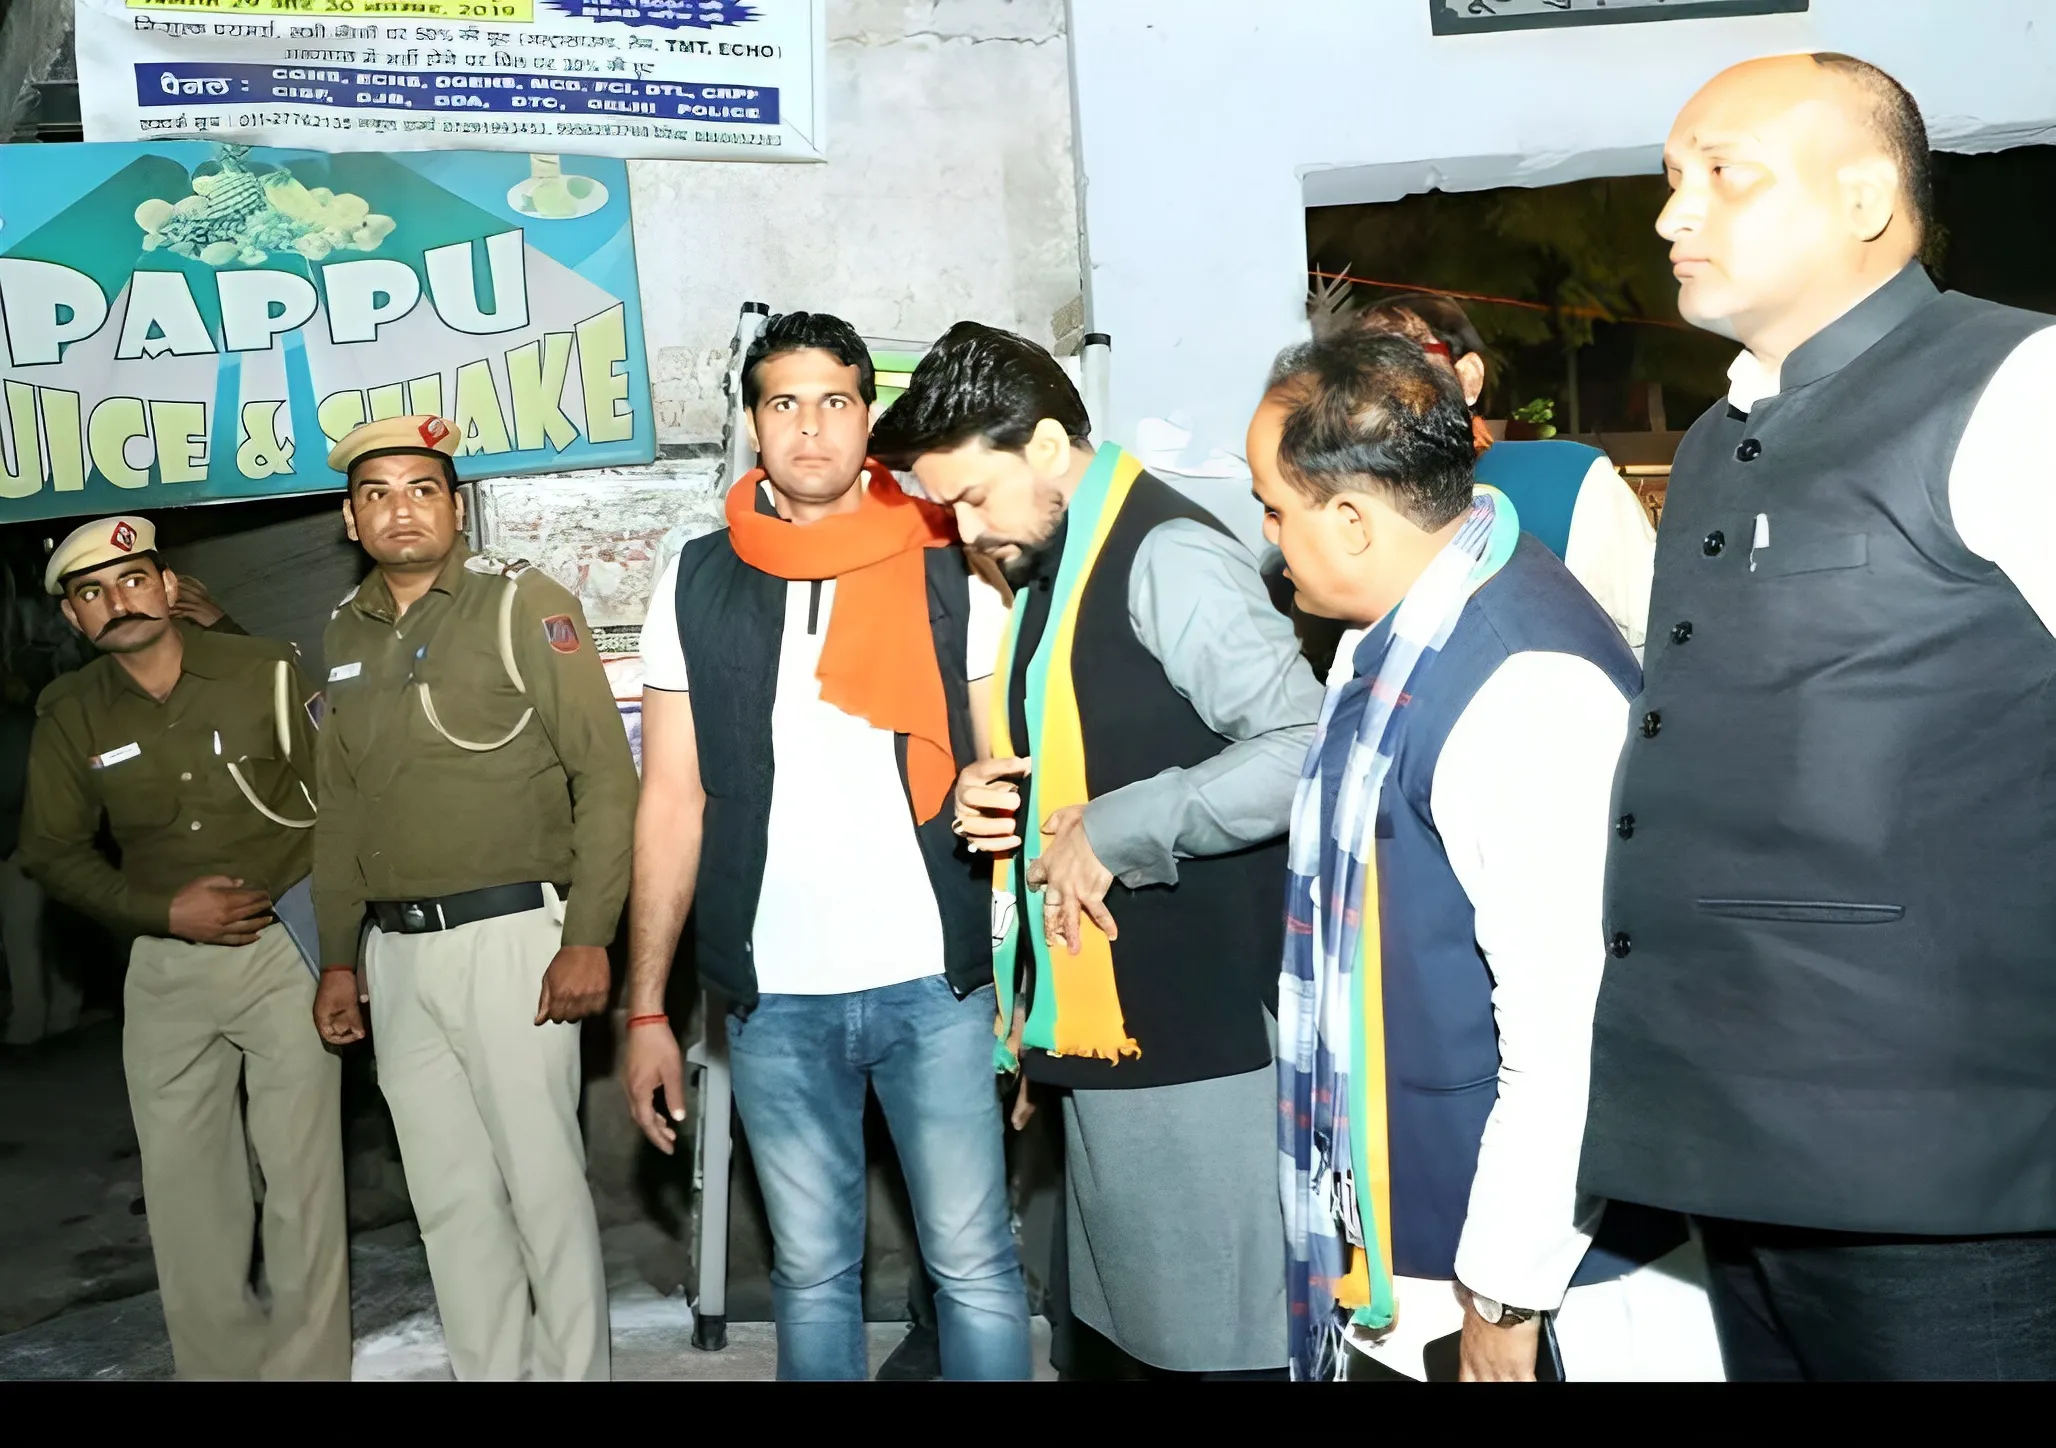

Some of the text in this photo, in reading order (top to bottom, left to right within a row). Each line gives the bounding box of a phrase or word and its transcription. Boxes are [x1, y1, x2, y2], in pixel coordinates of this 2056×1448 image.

[160, 71, 233, 95] पैनल
[678, 103, 760, 119] POLICE
[0, 227, 530, 366] PAPPU
[236, 399, 296, 480] &
